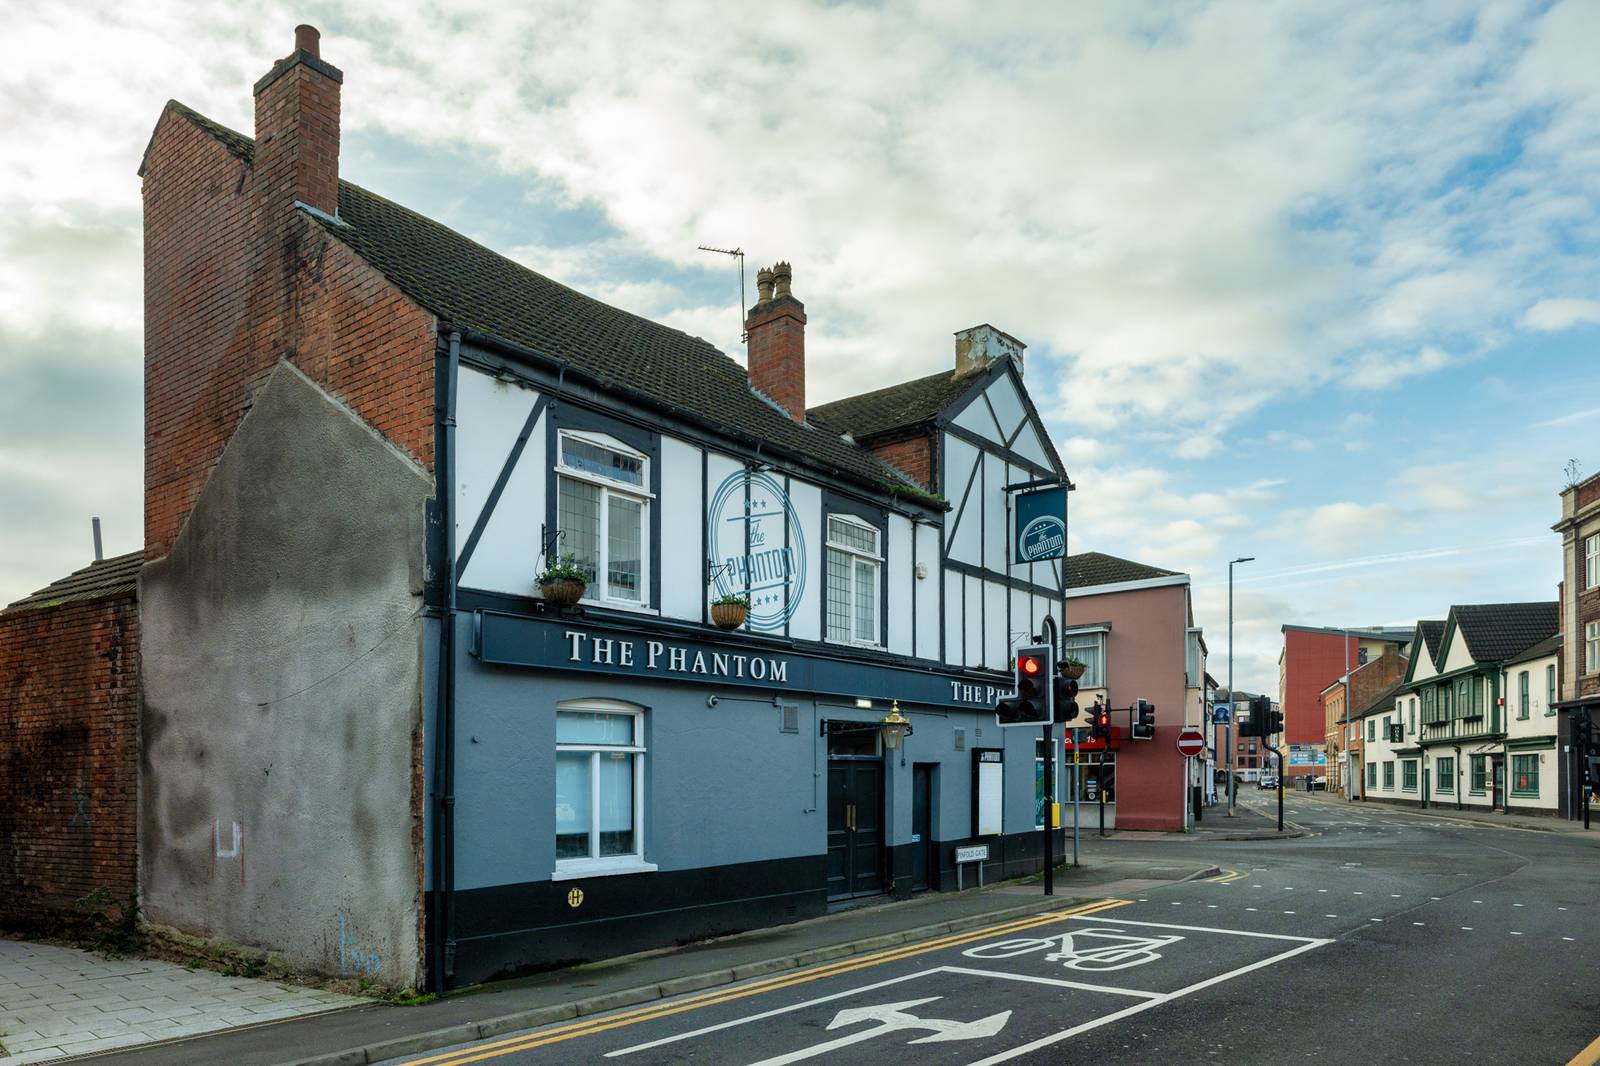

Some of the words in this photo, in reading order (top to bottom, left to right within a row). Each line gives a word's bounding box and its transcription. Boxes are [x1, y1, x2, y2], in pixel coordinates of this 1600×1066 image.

[750, 523, 765, 544] the
[1027, 534, 1063, 557] PHANTOM
[726, 547, 796, 586] PHANTOM
[565, 631, 633, 667] THE
[646, 640, 788, 683] PHANTOM
[951, 681, 982, 703] THE
